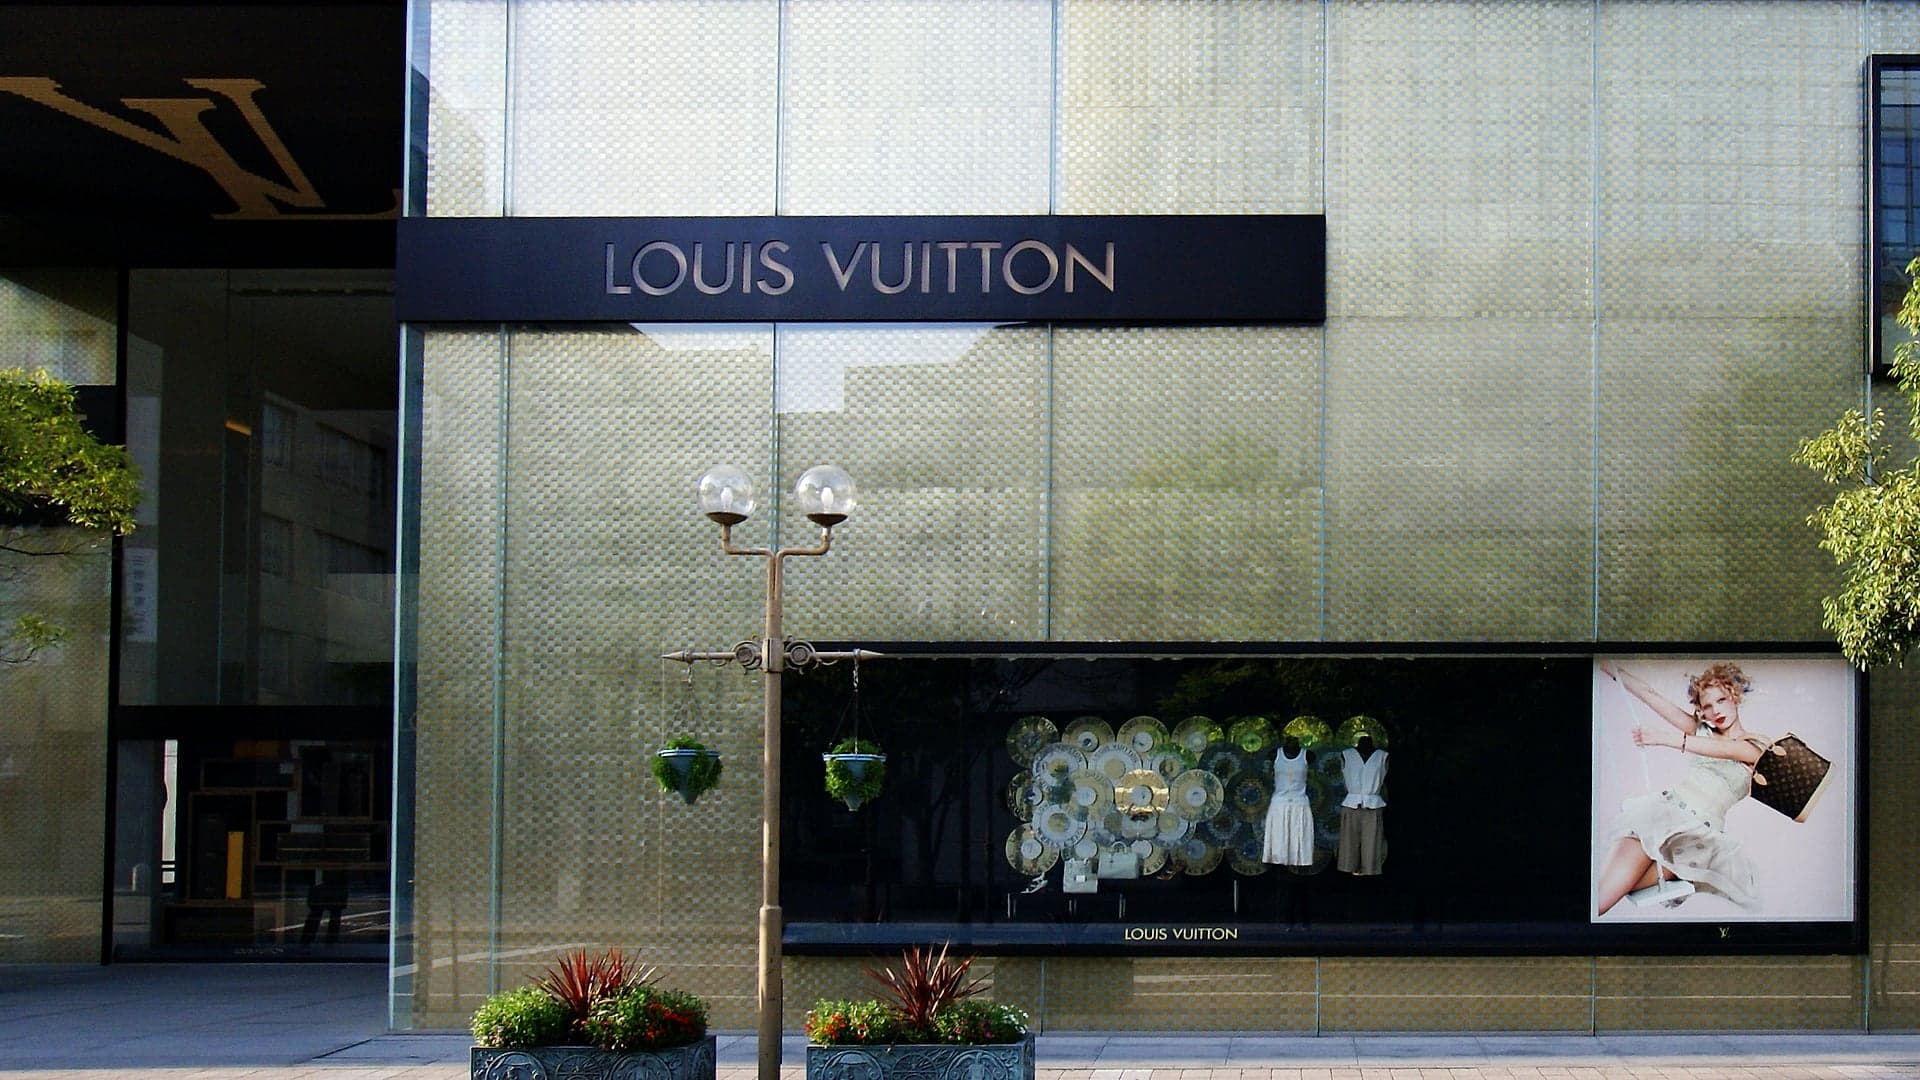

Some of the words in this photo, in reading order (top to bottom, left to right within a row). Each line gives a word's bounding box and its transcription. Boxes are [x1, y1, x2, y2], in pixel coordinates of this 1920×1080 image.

[605, 240, 795, 296] LOUIS
[819, 240, 1116, 296] VUITTON
[1124, 927, 1168, 940] LOUIS
[1172, 927, 1238, 940] VUITTON
